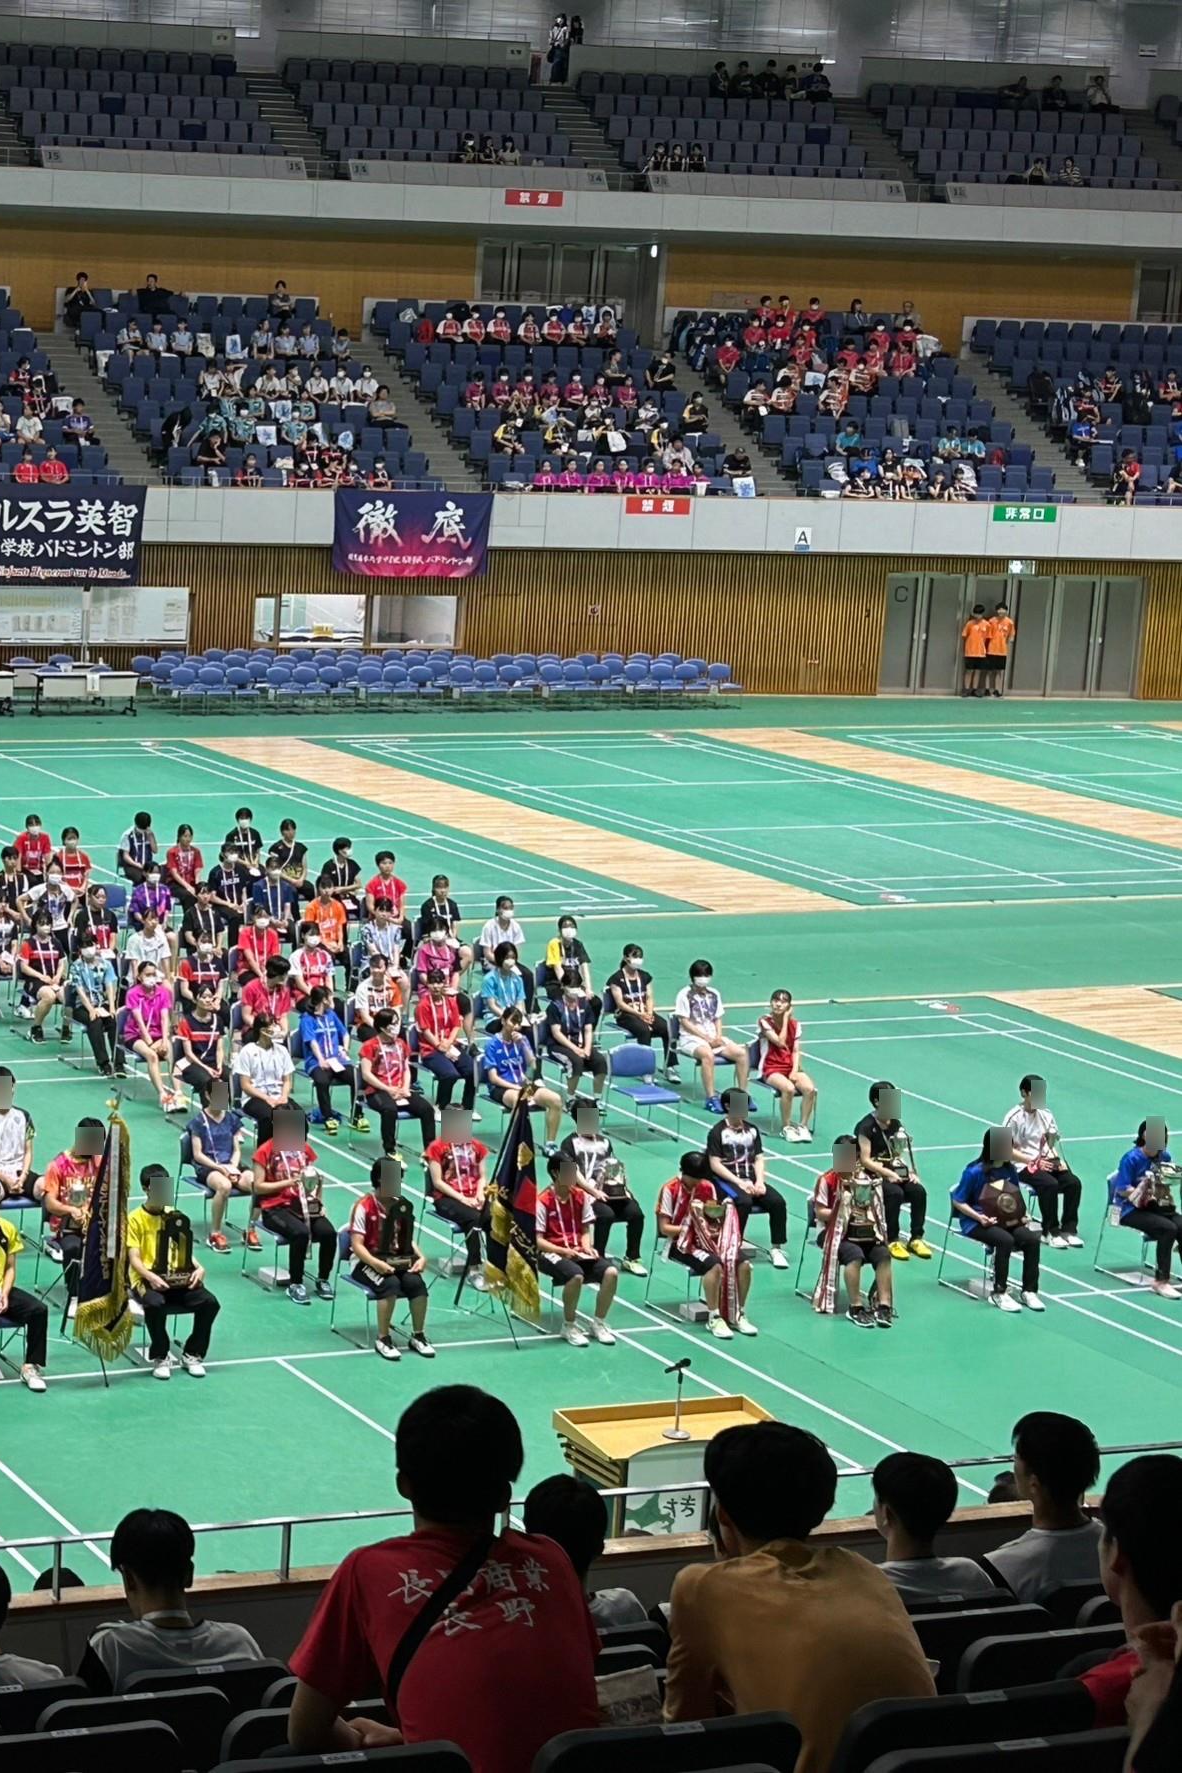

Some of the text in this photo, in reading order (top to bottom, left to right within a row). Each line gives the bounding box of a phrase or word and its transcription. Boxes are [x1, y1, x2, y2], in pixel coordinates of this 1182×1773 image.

[1005, 507, 1045, 520] 非常口
[352, 499, 472, 549] 徹底
[797, 530, 808, 544] A
[894, 585, 909, 603] C
[430, 1597, 536, 1636] 長野
